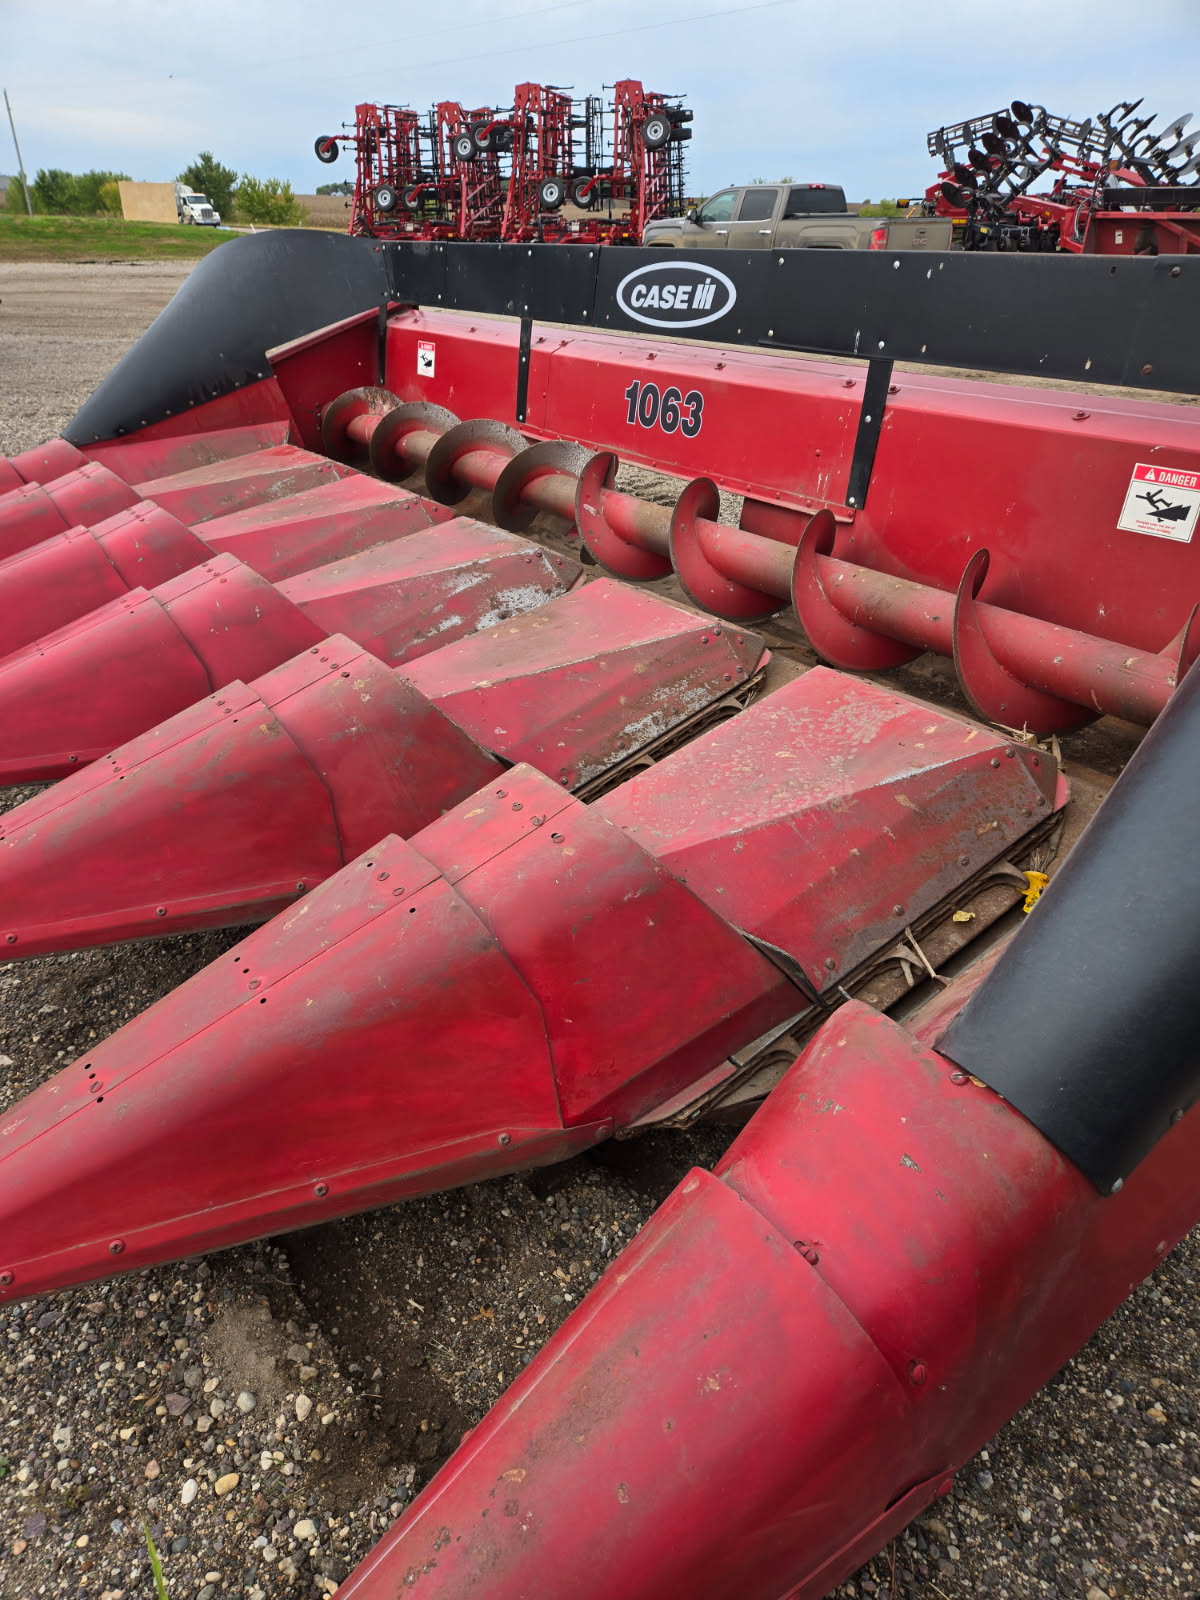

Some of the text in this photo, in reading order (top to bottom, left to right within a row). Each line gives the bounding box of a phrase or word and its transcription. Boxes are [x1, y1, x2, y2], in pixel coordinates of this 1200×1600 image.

[630, 283, 693, 310] CASE
[624, 379, 704, 438] 1063
[1158, 471, 1198, 488] DANGER
